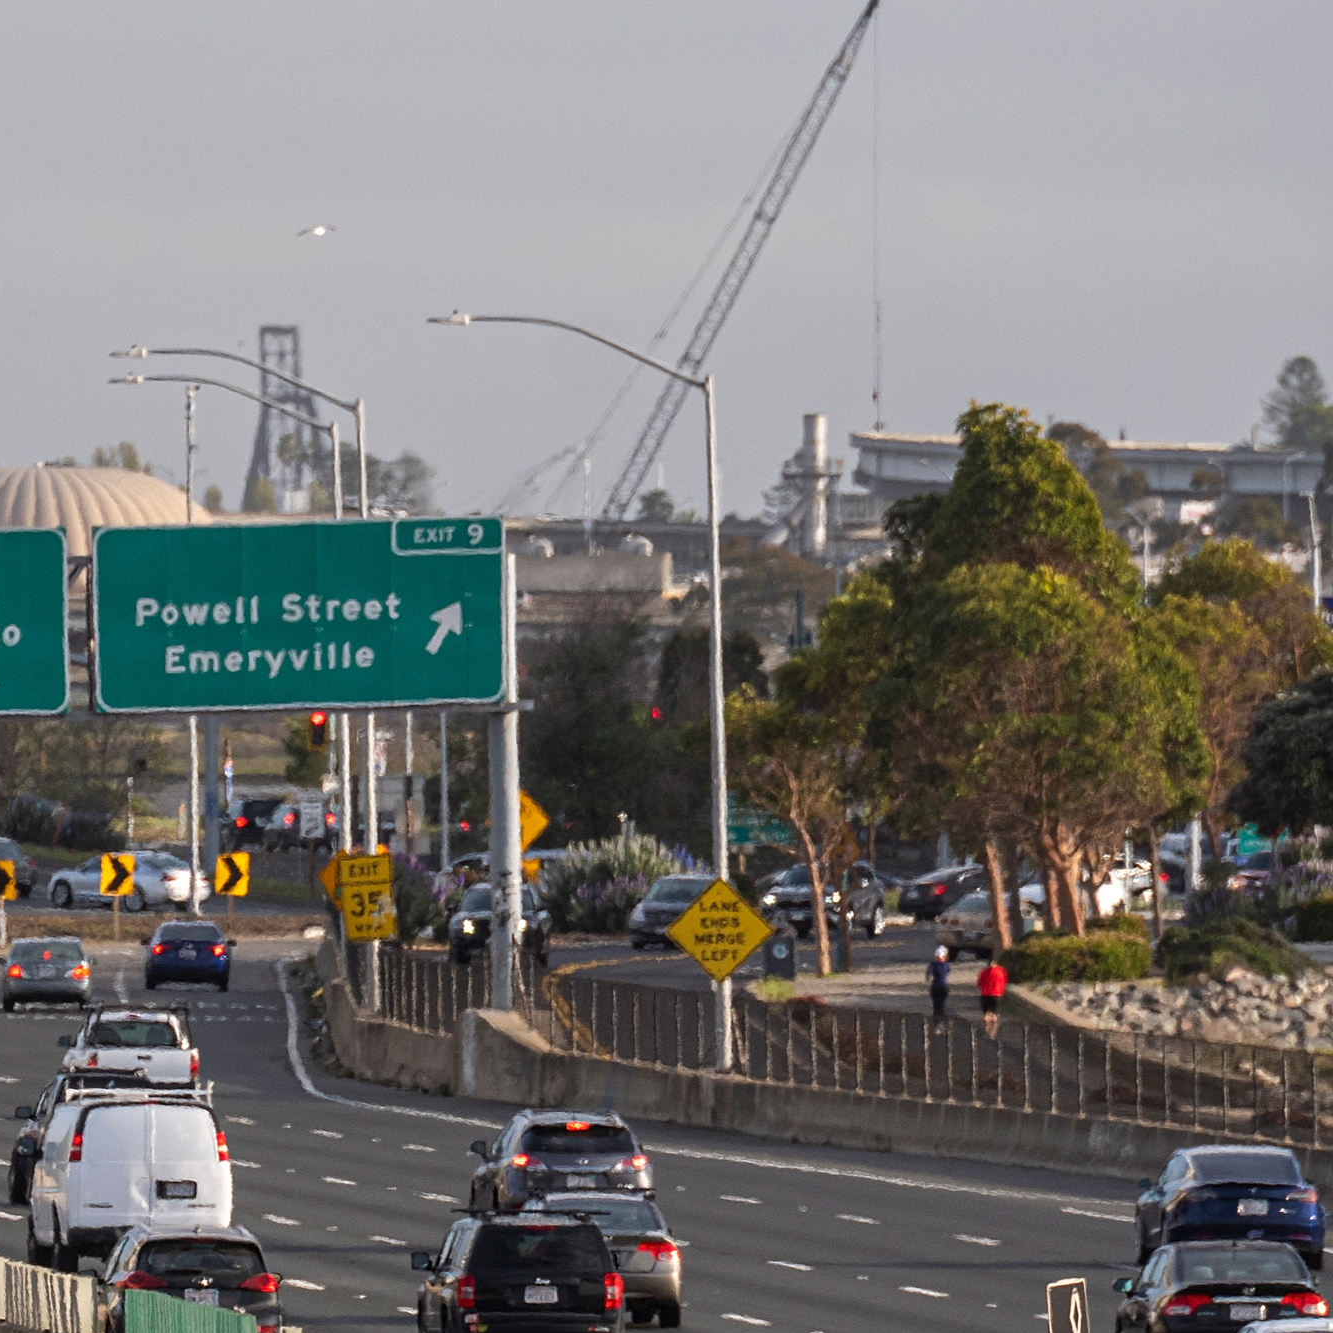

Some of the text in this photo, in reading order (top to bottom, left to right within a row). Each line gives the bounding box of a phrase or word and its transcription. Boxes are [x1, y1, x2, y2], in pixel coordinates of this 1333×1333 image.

[413, 524, 484, 544] EXIT 9
[136, 592, 401, 626] Powell Street
[164, 641, 375, 679] Emeryville
[349, 862, 378, 878] EXIT
[699, 902, 739, 913] LANE
[694, 932, 745, 945] MERGE
[701, 949, 739, 961] LEFT
